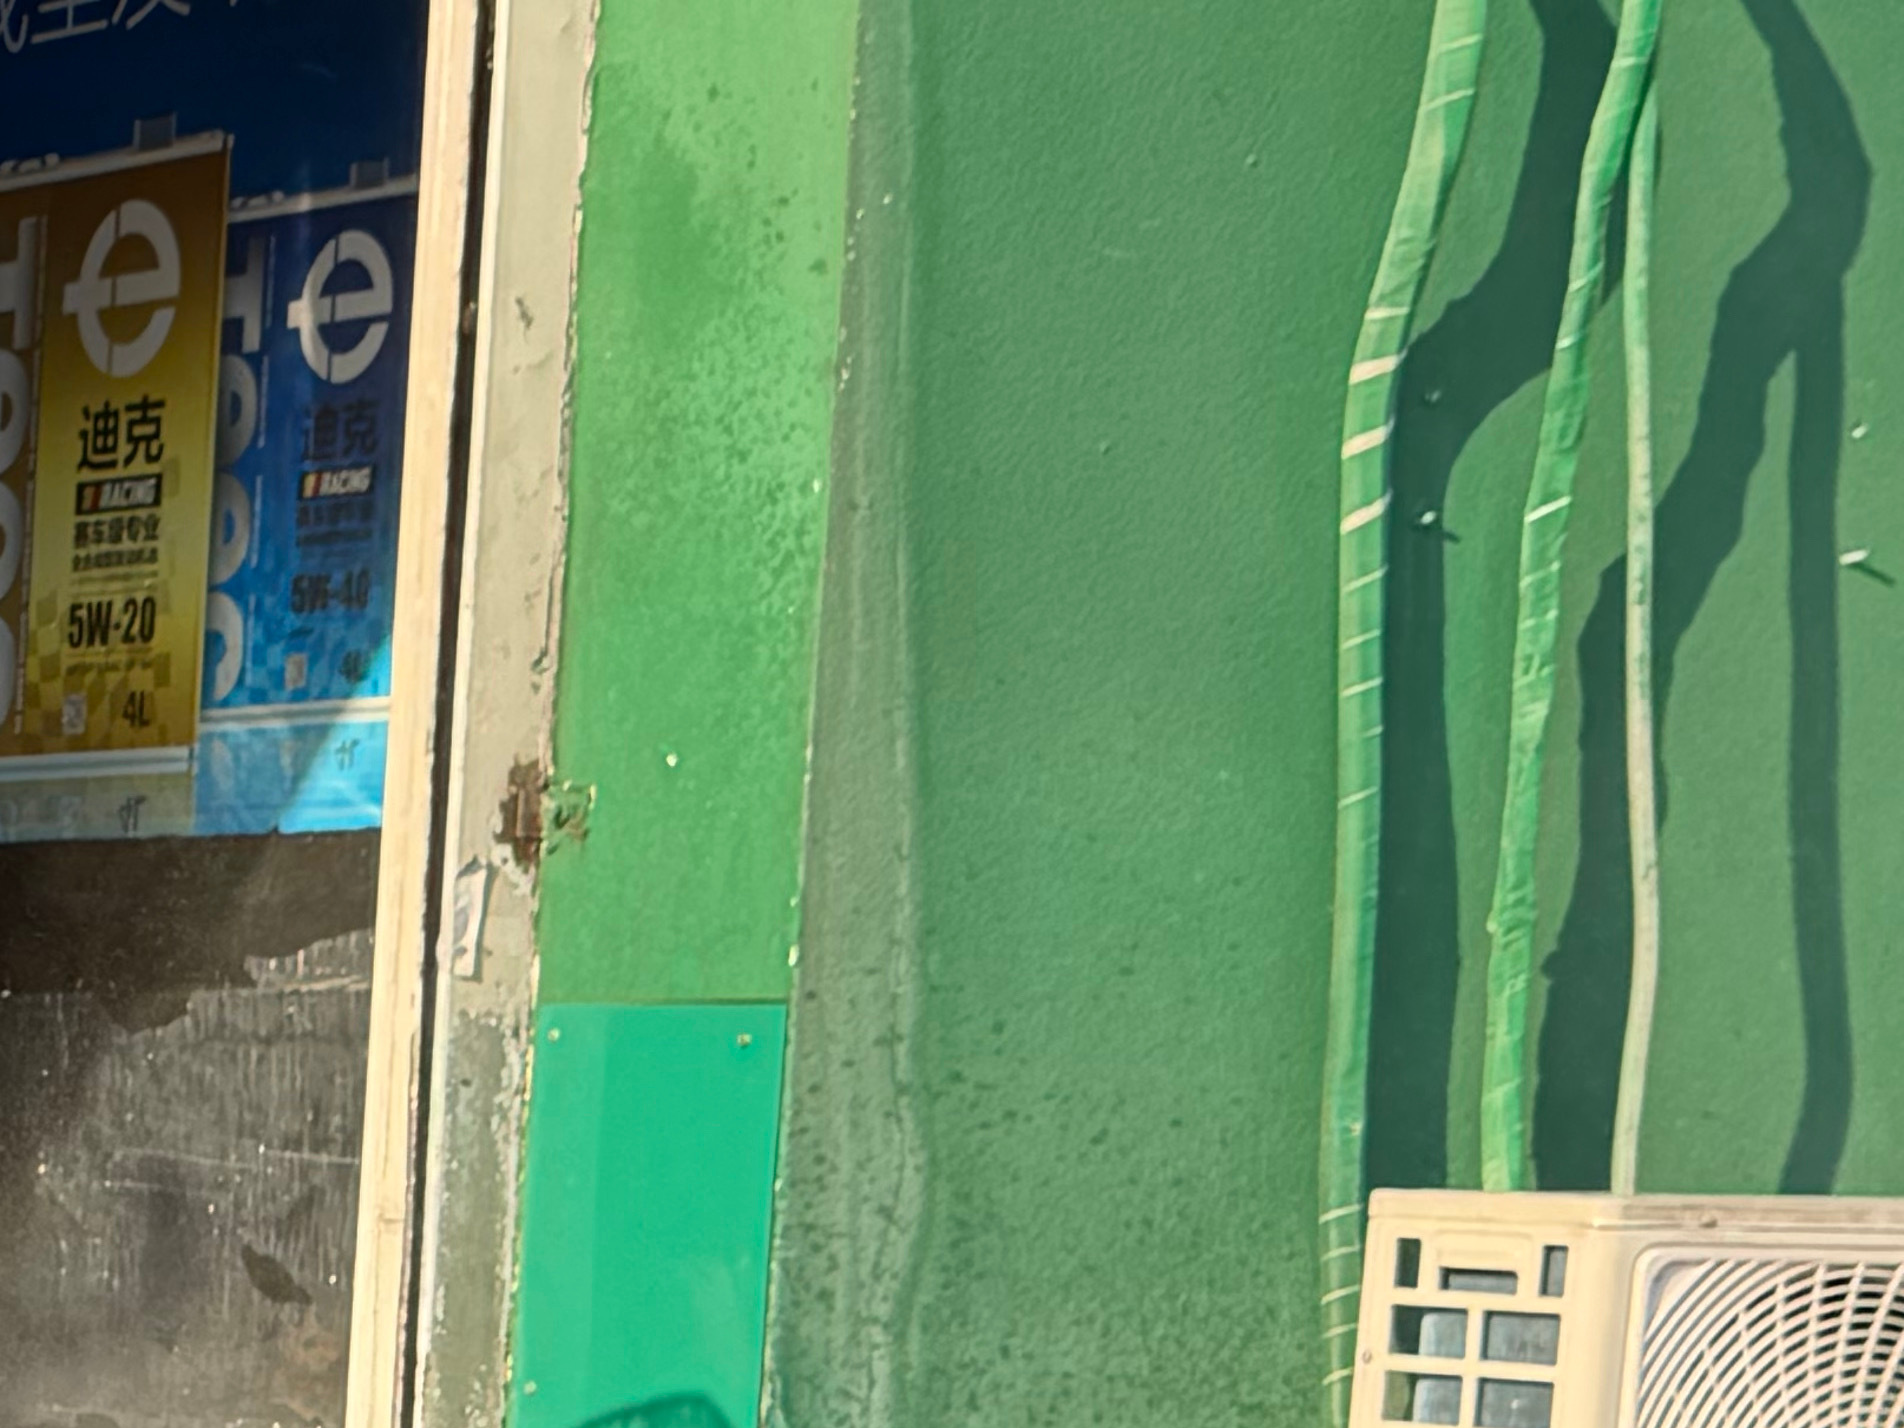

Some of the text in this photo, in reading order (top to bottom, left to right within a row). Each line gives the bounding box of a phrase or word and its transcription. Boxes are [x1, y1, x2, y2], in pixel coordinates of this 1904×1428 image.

[77, 393, 165, 472] 迪克
[303, 396, 378, 460] 迪克
[98, 476, 158, 510] RACING
[68, 596, 156, 648] 5W-20
[121, 690, 151, 728] 4L
